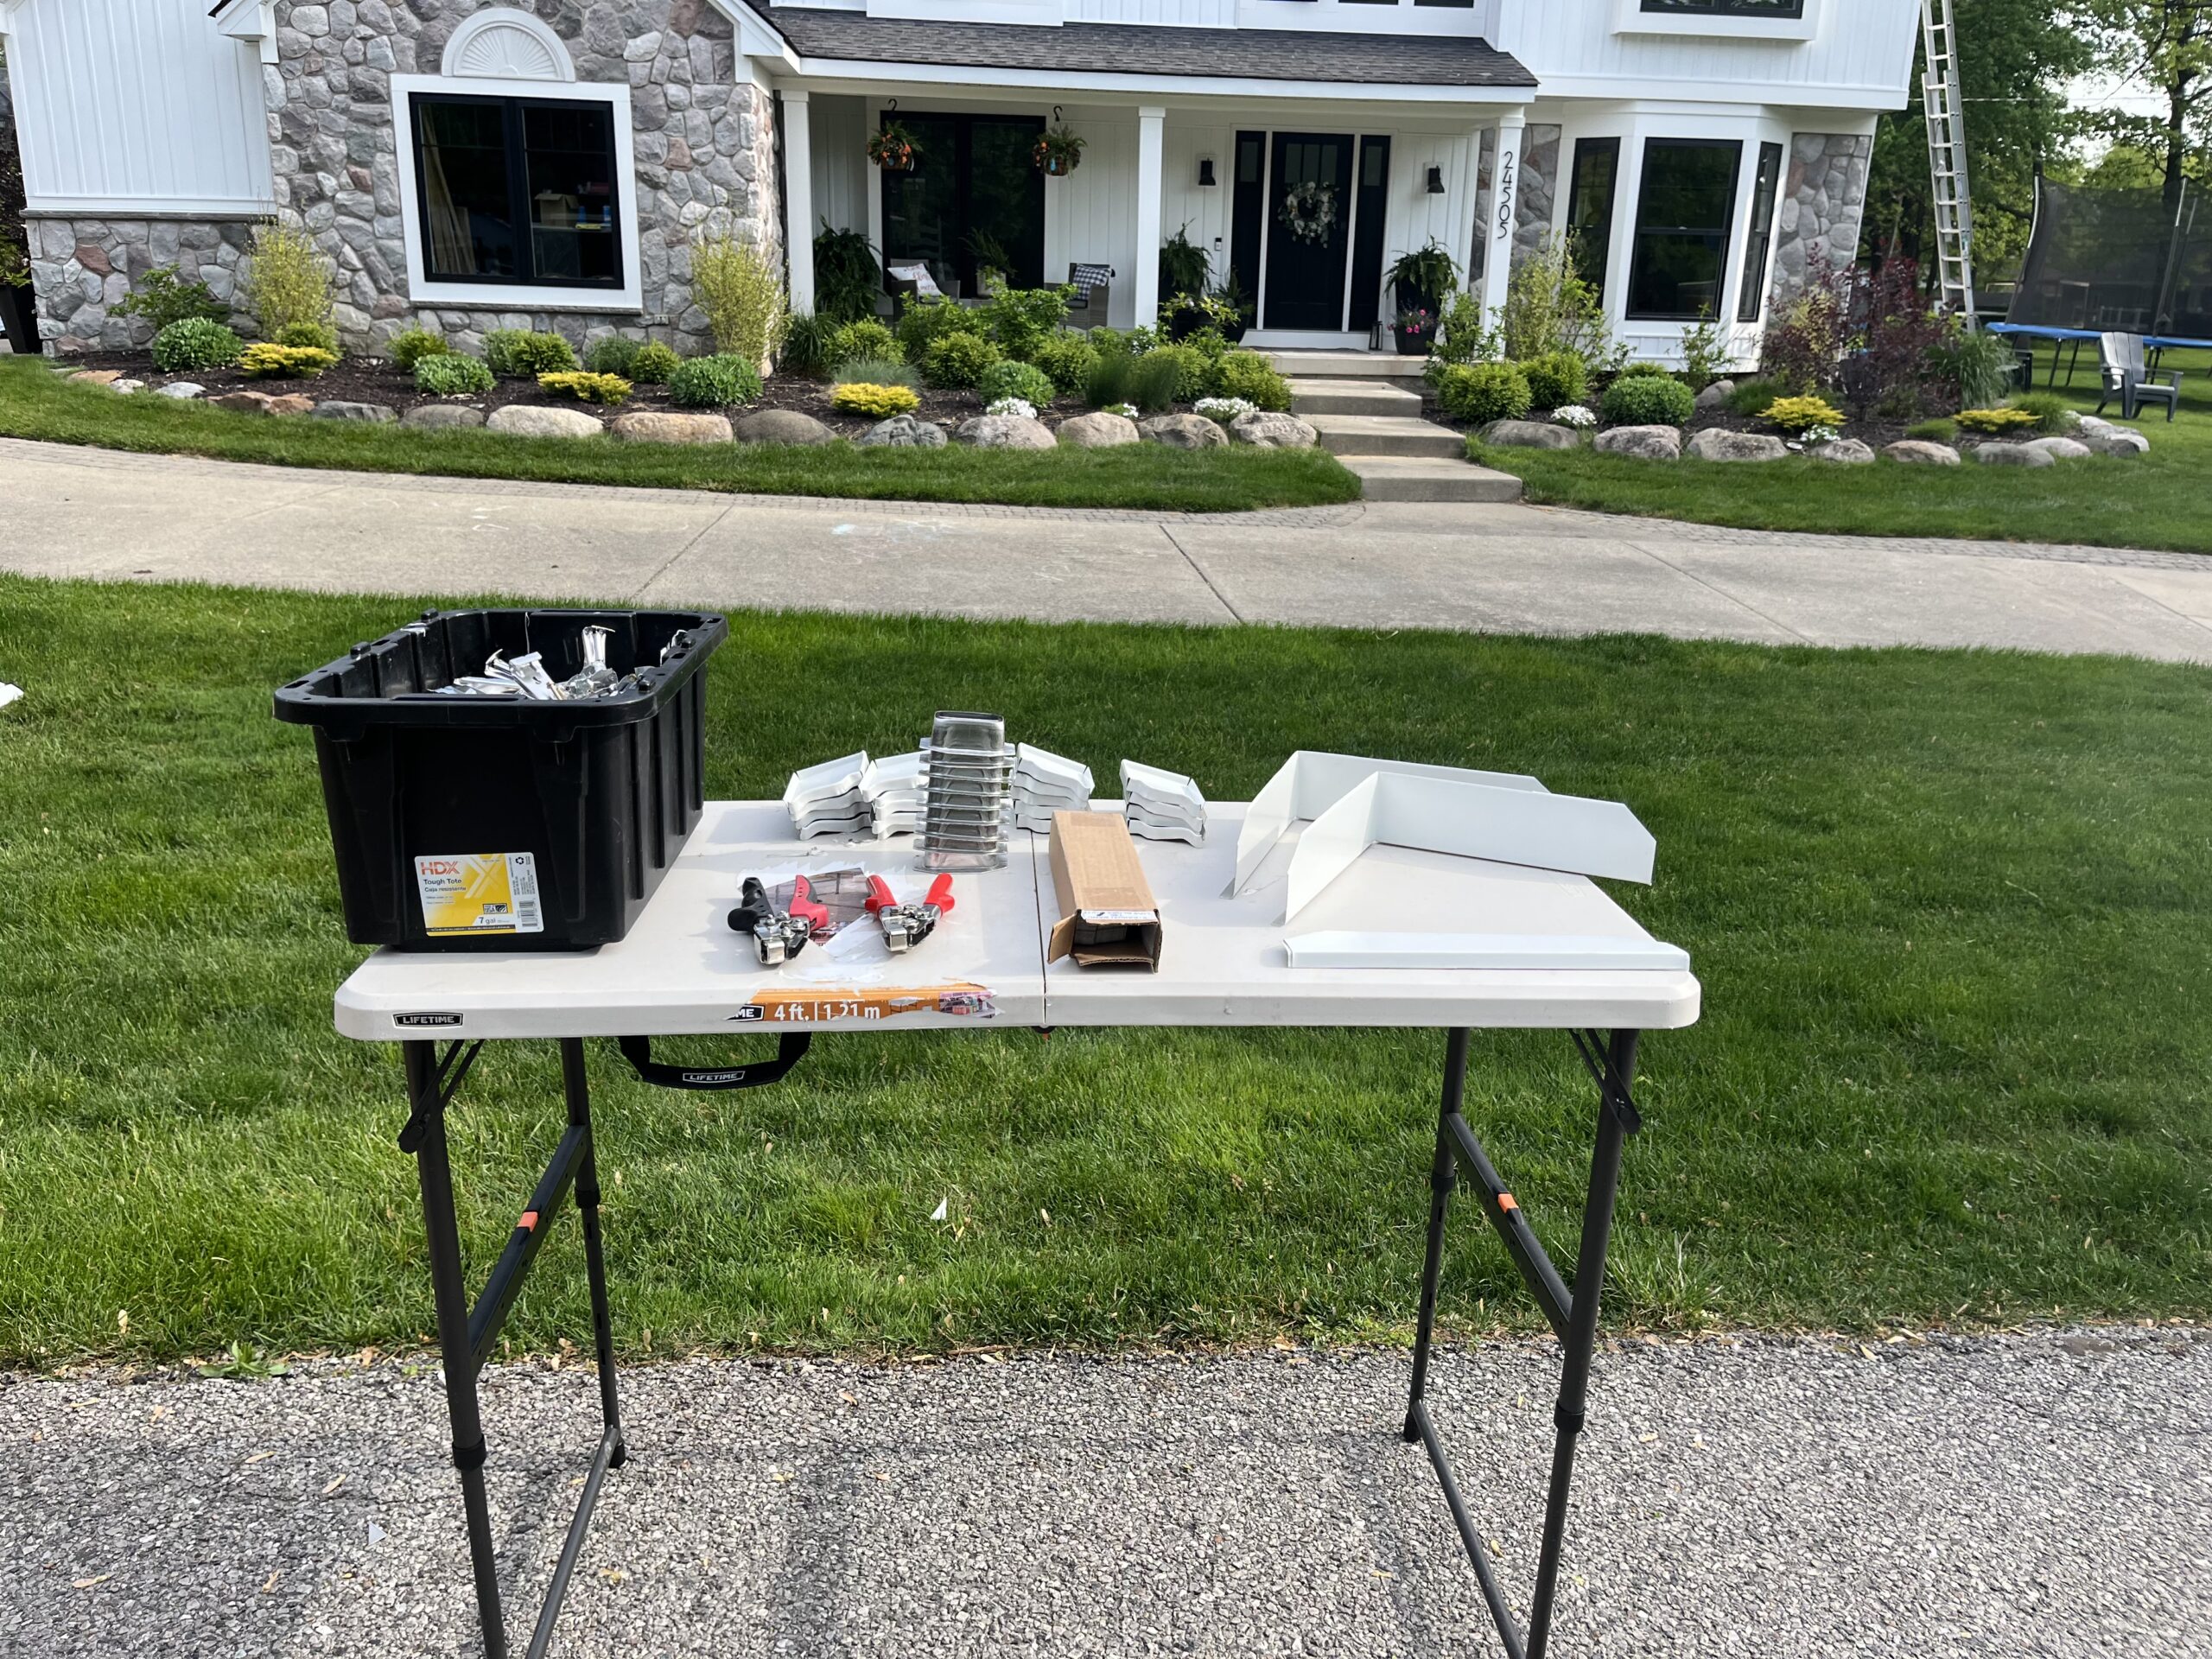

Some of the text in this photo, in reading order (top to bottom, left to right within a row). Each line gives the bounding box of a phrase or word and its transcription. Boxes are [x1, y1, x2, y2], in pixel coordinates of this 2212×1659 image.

[1497, 150, 1513, 239] 24505
[420, 861, 460, 875] HDX
[403, 1015, 454, 1024] LIFETIME
[774, 1004, 785, 1020] 4
[864, 1007, 880, 1020] m
